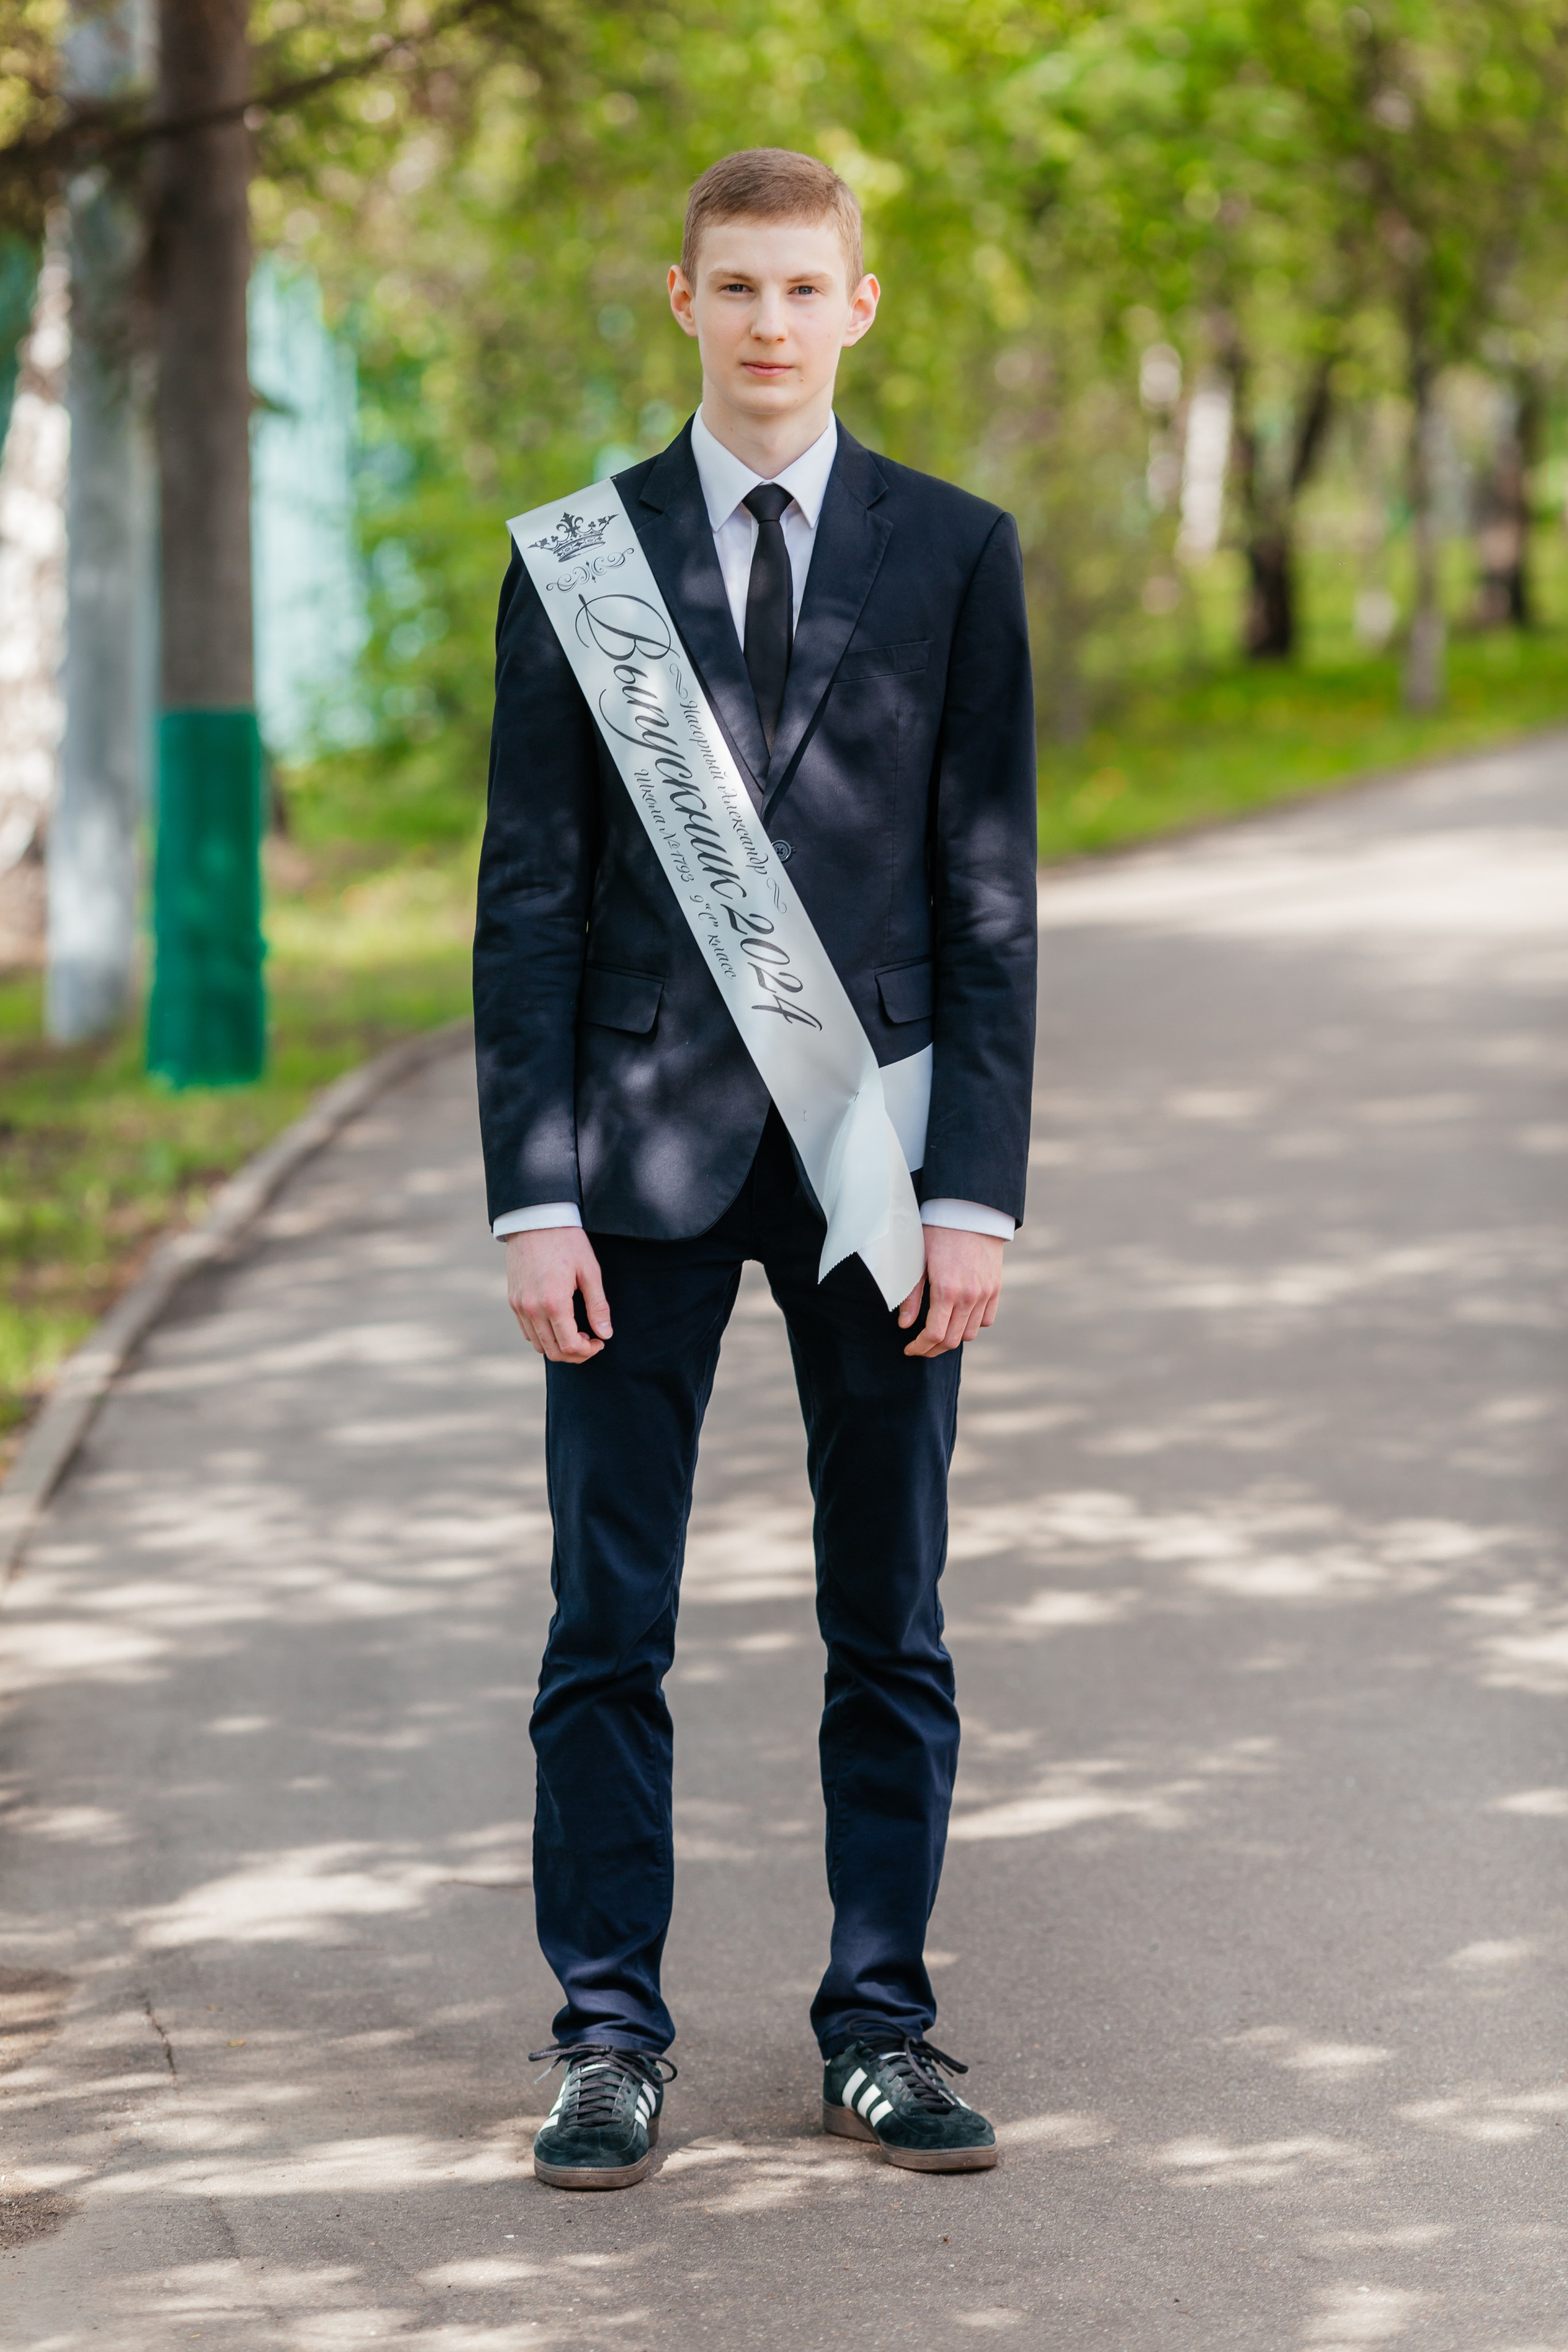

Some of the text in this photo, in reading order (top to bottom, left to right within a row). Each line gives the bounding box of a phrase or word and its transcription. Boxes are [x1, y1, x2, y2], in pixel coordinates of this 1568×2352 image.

[575, 593, 823, 1031] Выпускник 2024
[634, 769, 666, 825] Школа
[707, 934, 736, 979] класс
[680, 700, 769, 875] Нагорный Александр
